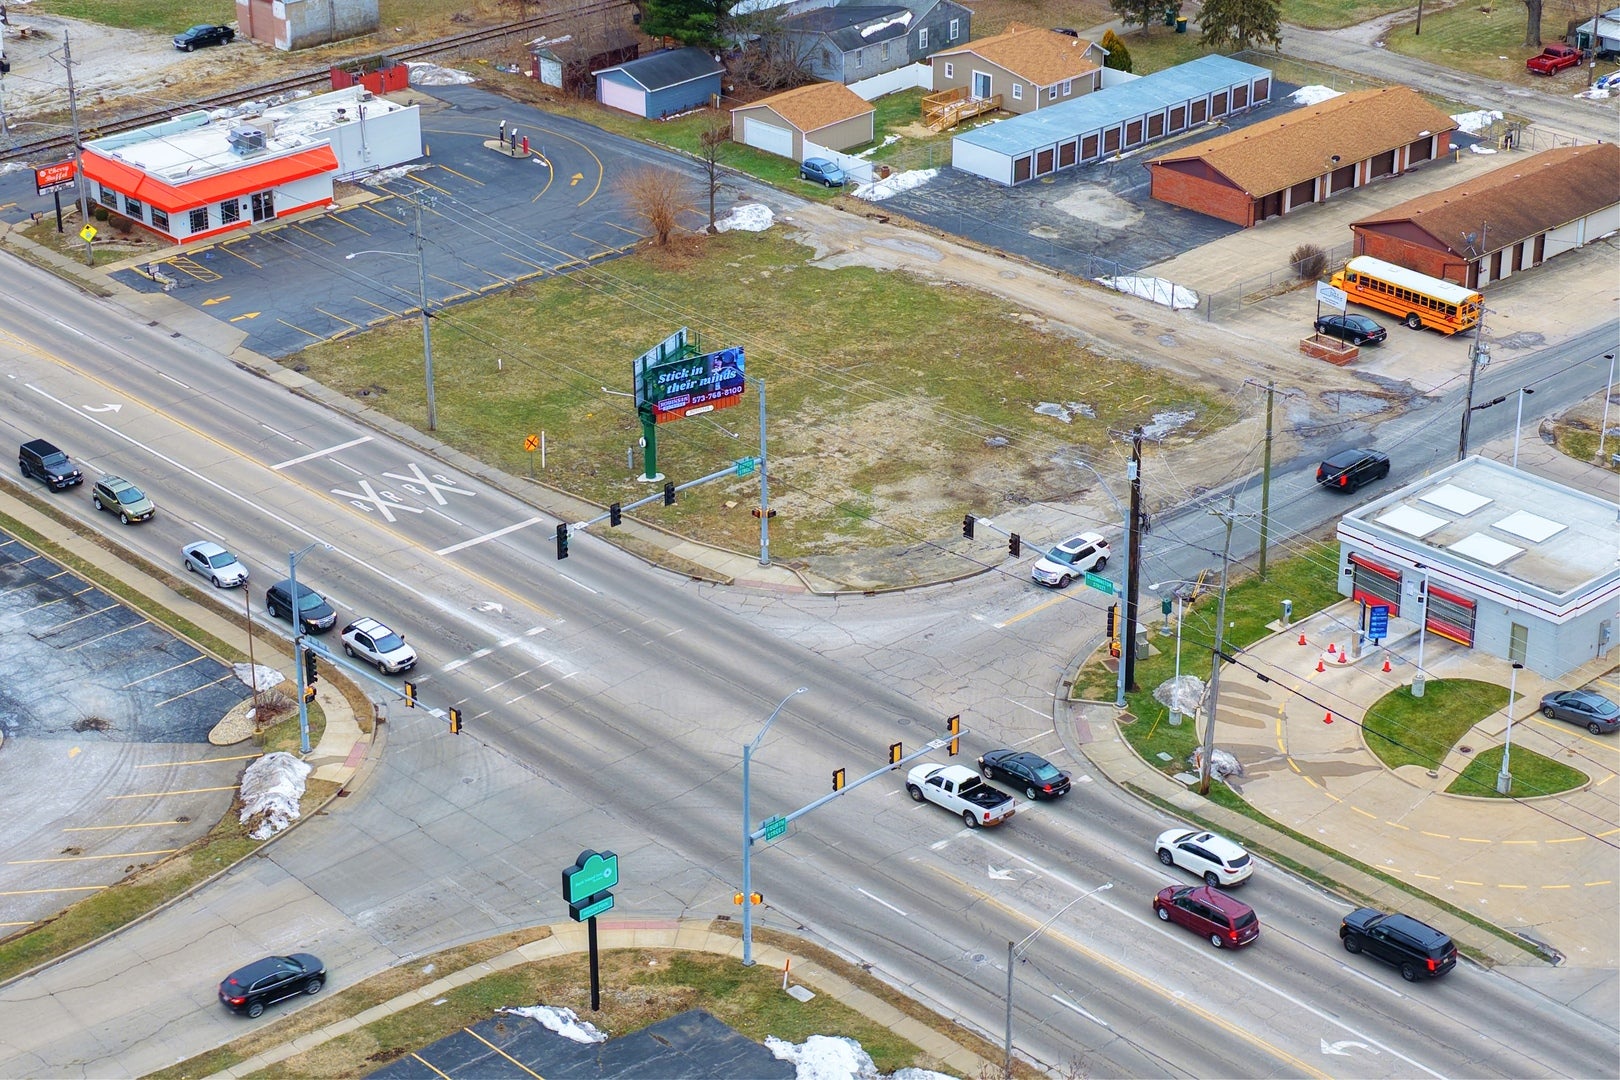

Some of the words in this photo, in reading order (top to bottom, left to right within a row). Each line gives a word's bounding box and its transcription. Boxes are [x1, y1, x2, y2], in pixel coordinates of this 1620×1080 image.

[658, 367, 689, 384] Stick
[691, 365, 703, 376] in
[666, 379, 697, 394] their
[700, 368, 737, 386] minds
[766, 818, 785, 832] FOURTH
[766, 825, 785, 839] STREET
